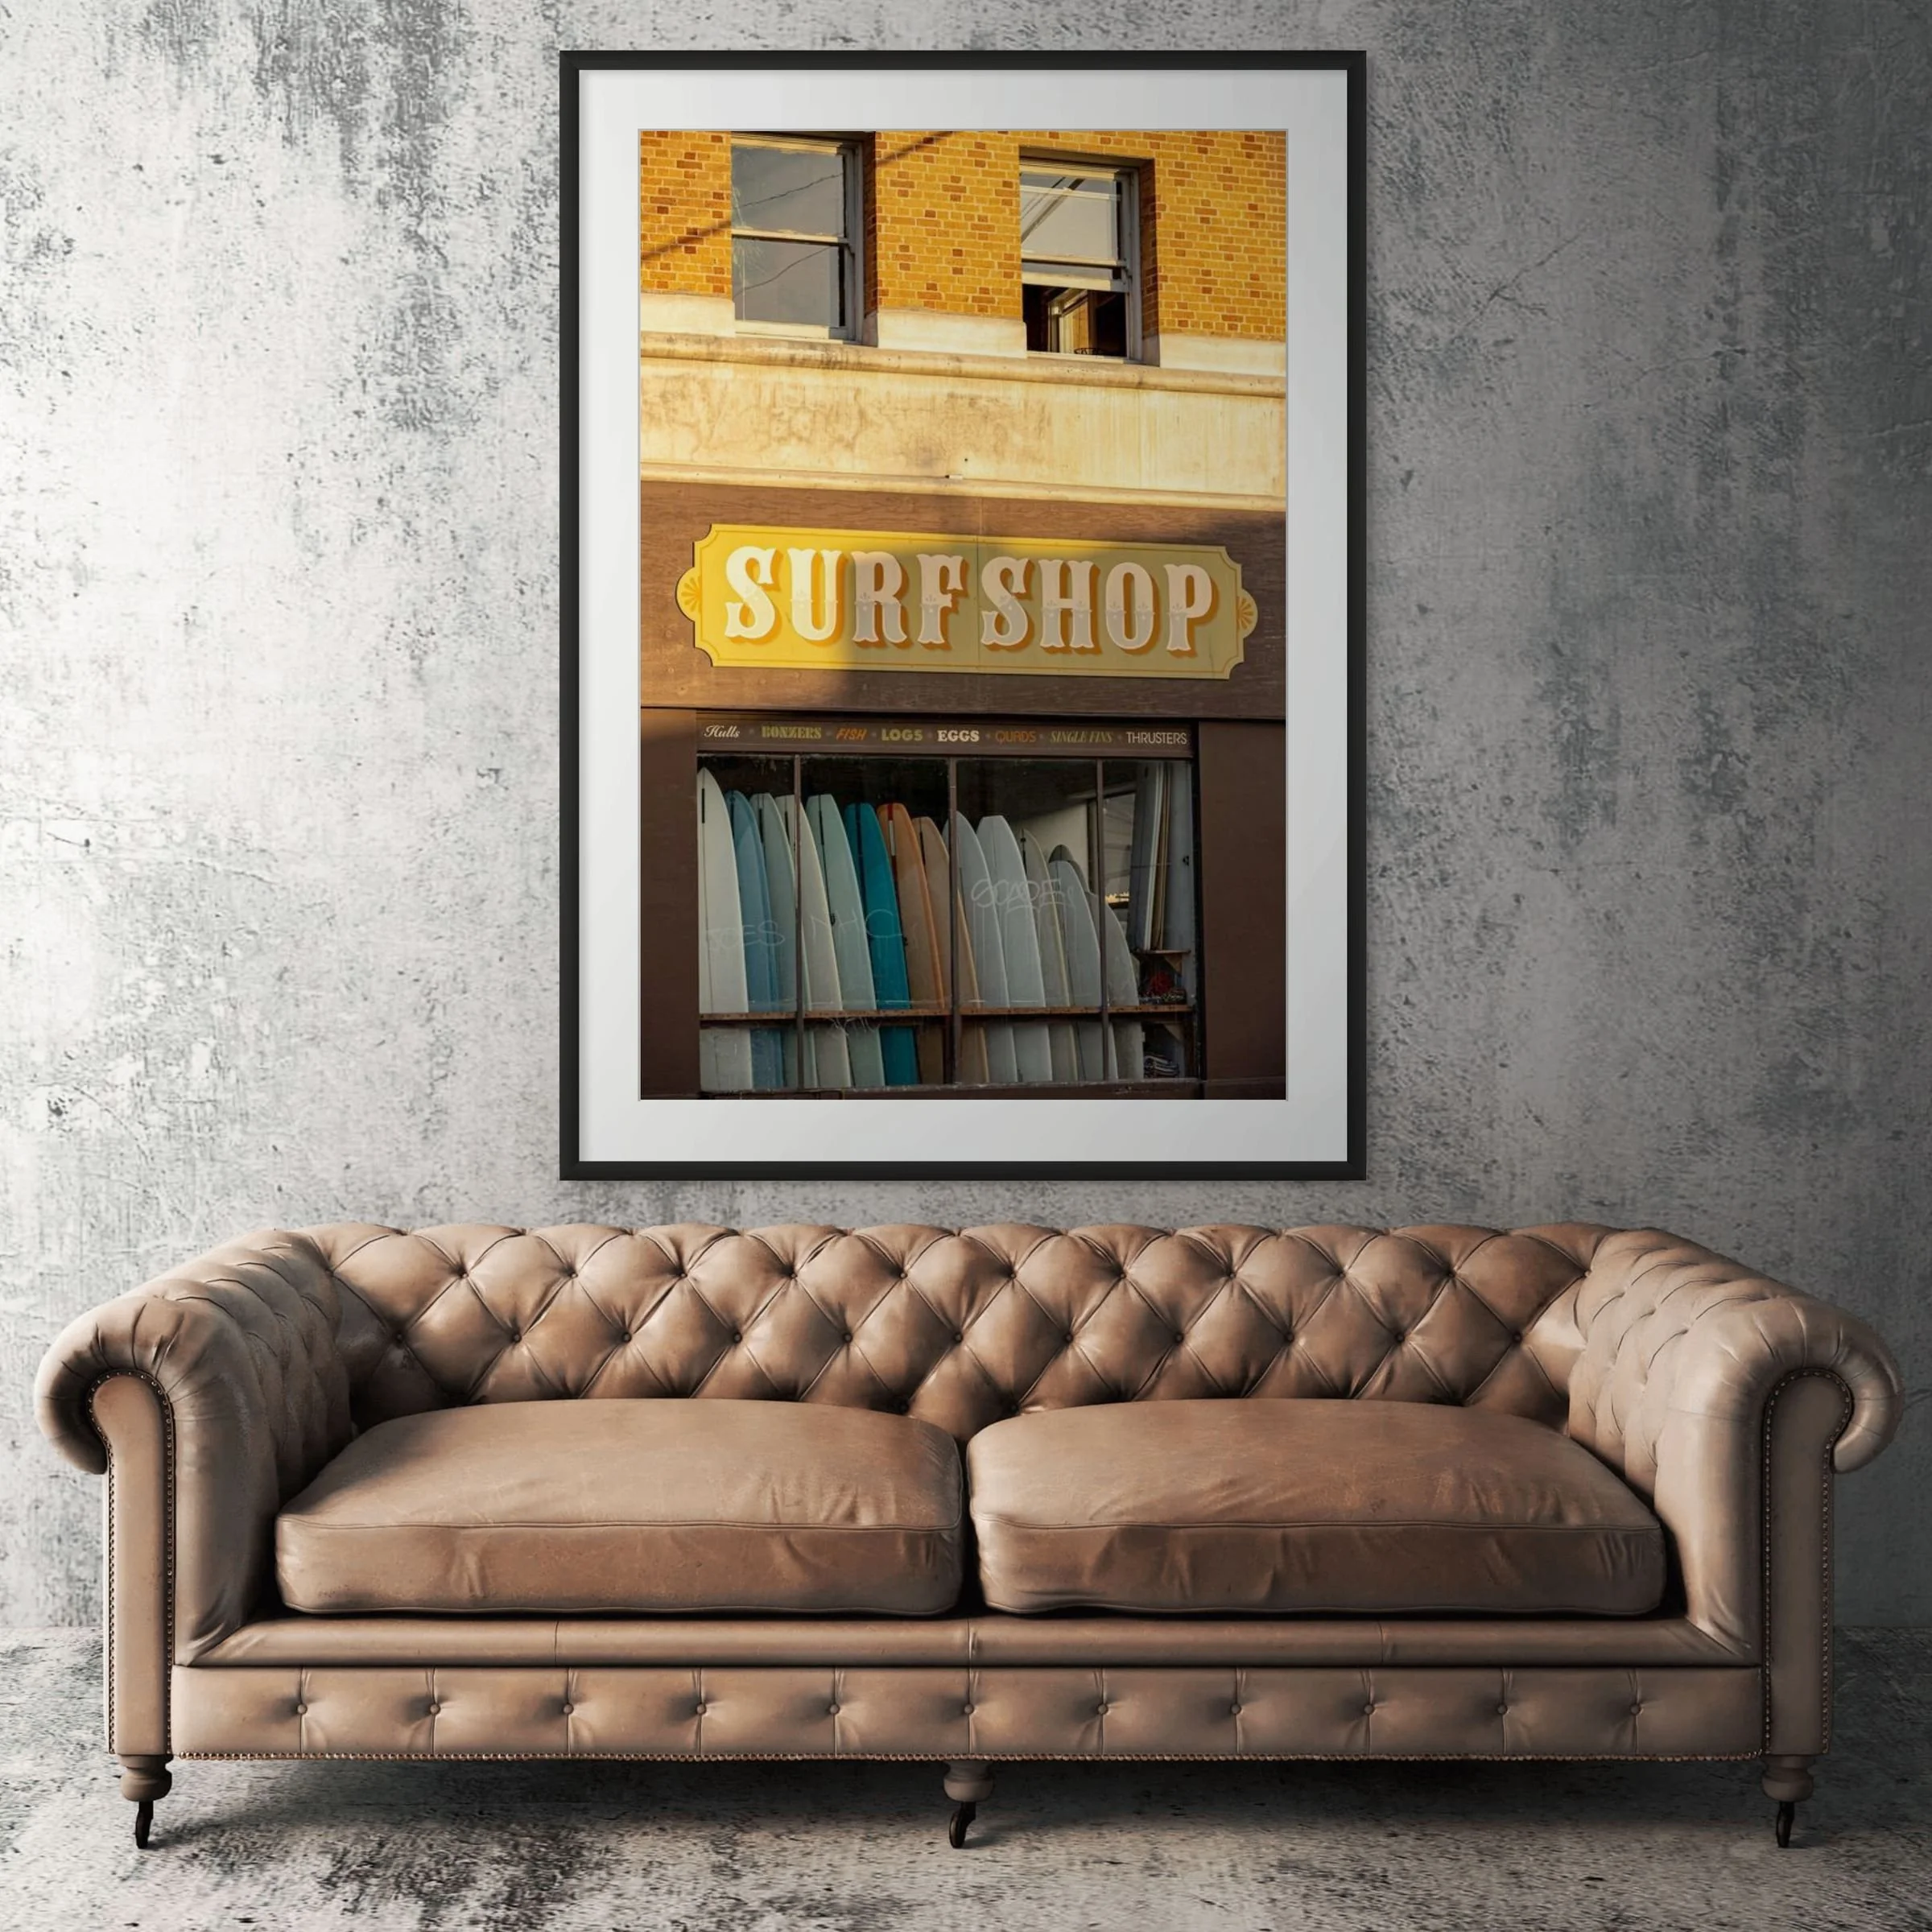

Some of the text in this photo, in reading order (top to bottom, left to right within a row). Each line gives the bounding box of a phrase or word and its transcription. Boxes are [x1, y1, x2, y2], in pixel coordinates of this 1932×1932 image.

[724, 546, 1214, 653] SURF SHOP
[762, 727, 821, 738] BONZERS
[836, 729, 867, 741] FISH
[881, 729, 923, 741] LOGS
[937, 730, 980, 742] EGGS
[996, 731, 1036, 744] QUADS
[1051, 731, 1088, 744] SINGLE
[1088, 732, 1113, 744] FINS
[1126, 732, 1187, 745] THRUSTERS
